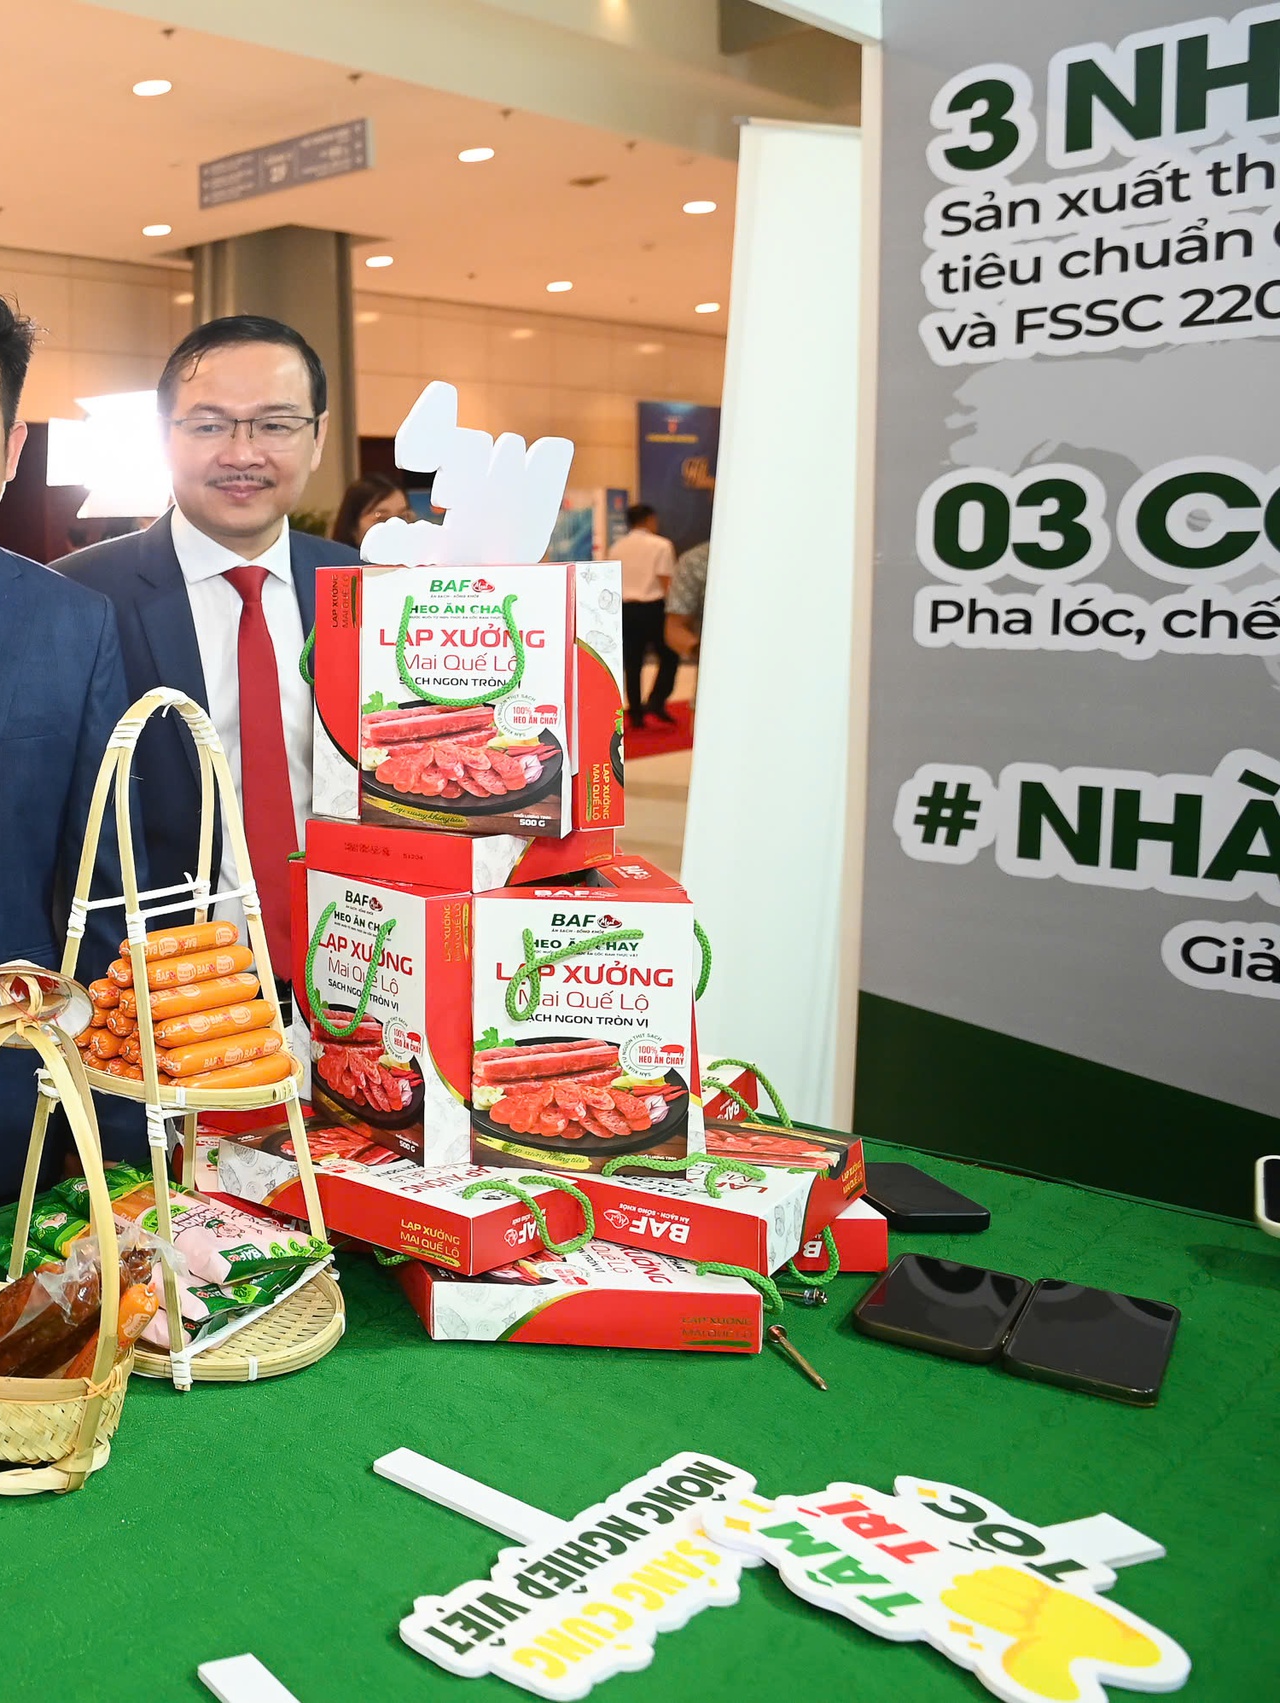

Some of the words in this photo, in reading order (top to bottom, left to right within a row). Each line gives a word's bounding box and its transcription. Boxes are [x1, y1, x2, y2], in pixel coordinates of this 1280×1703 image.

[944, 79, 1020, 171] 3
[940, 191, 1041, 237] Sản
[1057, 160, 1191, 221] xuất
[1206, 152, 1275, 197] th
[938, 251, 1041, 294] tiêu
[1059, 218, 1253, 279] chuẩn
[936, 312, 996, 351] và
[1016, 295, 1164, 345] FSSC
[934, 478, 1092, 570] 03
[1135, 472, 1280, 569] C
[429, 579, 471, 592] BAF
[410, 605, 439, 614] HEO
[443, 603, 465, 614] ĂN
[470, 605, 503, 614] CHA
[930, 599, 1032, 635] Pha
[1051, 597, 1146, 644] lóc,
[444, 653, 487, 671] Quế
[399, 677, 430, 687] SCH
[433, 678, 468, 687] NGON
[471, 676, 507, 687] TRÒN
[513, 716, 526, 724] HEO
[540, 717, 558, 725] CHAY
[913, 781, 981, 847] #
[1017, 768, 1280, 882] NHÀ
[345, 890, 369, 907] BAF
[334, 911, 351, 923] HEO
[354, 915, 365, 928] ĂN
[368, 922, 393, 935] CHY
[551, 914, 596, 927] BAF
[1181, 934, 1280, 984] Giả
[328, 957, 350, 978] Mai
[381, 975, 399, 997] Lộ
[496, 962, 555, 986] LP
[562, 960, 673, 988] XƯỞNG
[328, 979, 346, 991] SẠCH
[369, 993, 390, 1007] TRÒN
[566, 990, 614, 1010] Quế
[620, 992, 650, 1013] Lộ
[523, 1013, 552, 1024] ẠCH
[554, 1014, 591, 1025] NGON
[596, 1015, 634, 1026] TRÒN
[636, 1018, 649, 1029] VỊ
[638, 1046, 658, 1054] 100%
[638, 1056, 652, 1064] HEO
[666, 1057, 684, 1065] CHAY
[400, 1219, 422, 1232] LẠP
[423, 1225, 461, 1246] XƯỞNG
[400, 1231, 420, 1245] MAI
[421, 1239, 444, 1252] QUẾ
[518, 1216, 546, 1244] AF
[629, 1216, 691, 1244] BAF
[240, 1248, 263, 1261] BAF
[626, 1461, 736, 1525] NÔNG
[797, 1500, 940, 1565] TRÍ
[920, 1494, 1089, 1584] TỐC
[514, 1514, 650, 1601] NGHIỆP
[757, 1521, 924, 1618] TÂM
[612, 1539, 721, 1612] SÁNG
[424, 1592, 532, 1656] VIỆT
[512, 1603, 634, 1679] CÙNG
